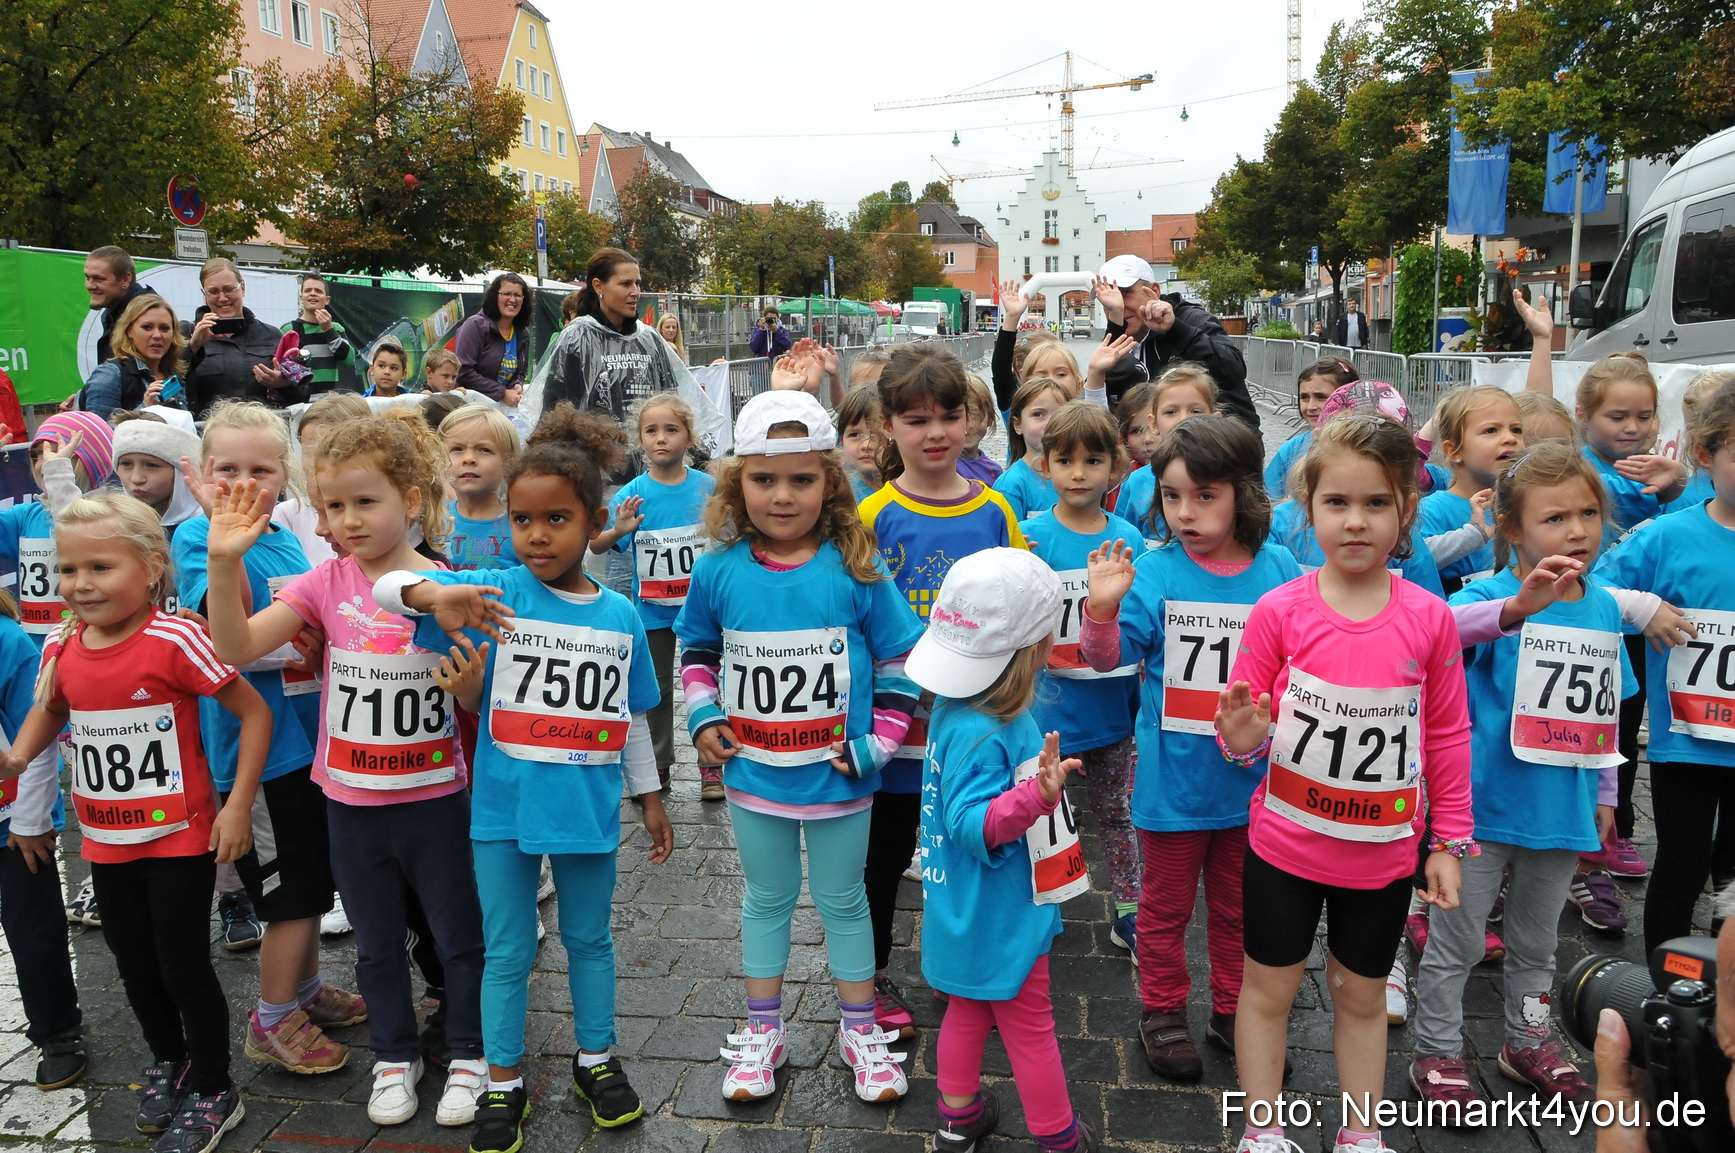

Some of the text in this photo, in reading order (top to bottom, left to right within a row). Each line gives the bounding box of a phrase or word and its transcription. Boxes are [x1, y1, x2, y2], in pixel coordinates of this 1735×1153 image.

[537, 222, 544, 247] P
[666, 584, 690, 596] Ann
[1168, 614, 1246, 630] PARTL Neu
[1688, 622, 1726, 636] RTL
[503, 631, 615, 657] PARTL Neumarkt
[725, 641, 824, 658] PARTL Neumarkt
[1524, 637, 1576, 654] PARTL
[1180, 634, 1230, 684] 71
[331, 662, 366, 679] PARTL
[512, 654, 621, 713] 7502
[732, 662, 839, 714] 7024
[338, 684, 446, 737] 7103
[1288, 683, 1406, 719] PARTL Neumarkt
[1704, 702, 1735, 723] He
[81, 722, 149, 737] Neumarkt
[741, 723, 830, 749] Magdalena
[1536, 721, 1582, 746] Julia
[1290, 708, 1407, 783] 7121
[351, 749, 425, 770] Mareike
[1306, 787, 1381, 820] Sophie
[86, 804, 145, 825] Madlen
[1668, 959, 1698, 973] FTM26
[591, 1064, 608, 1074] FILA
